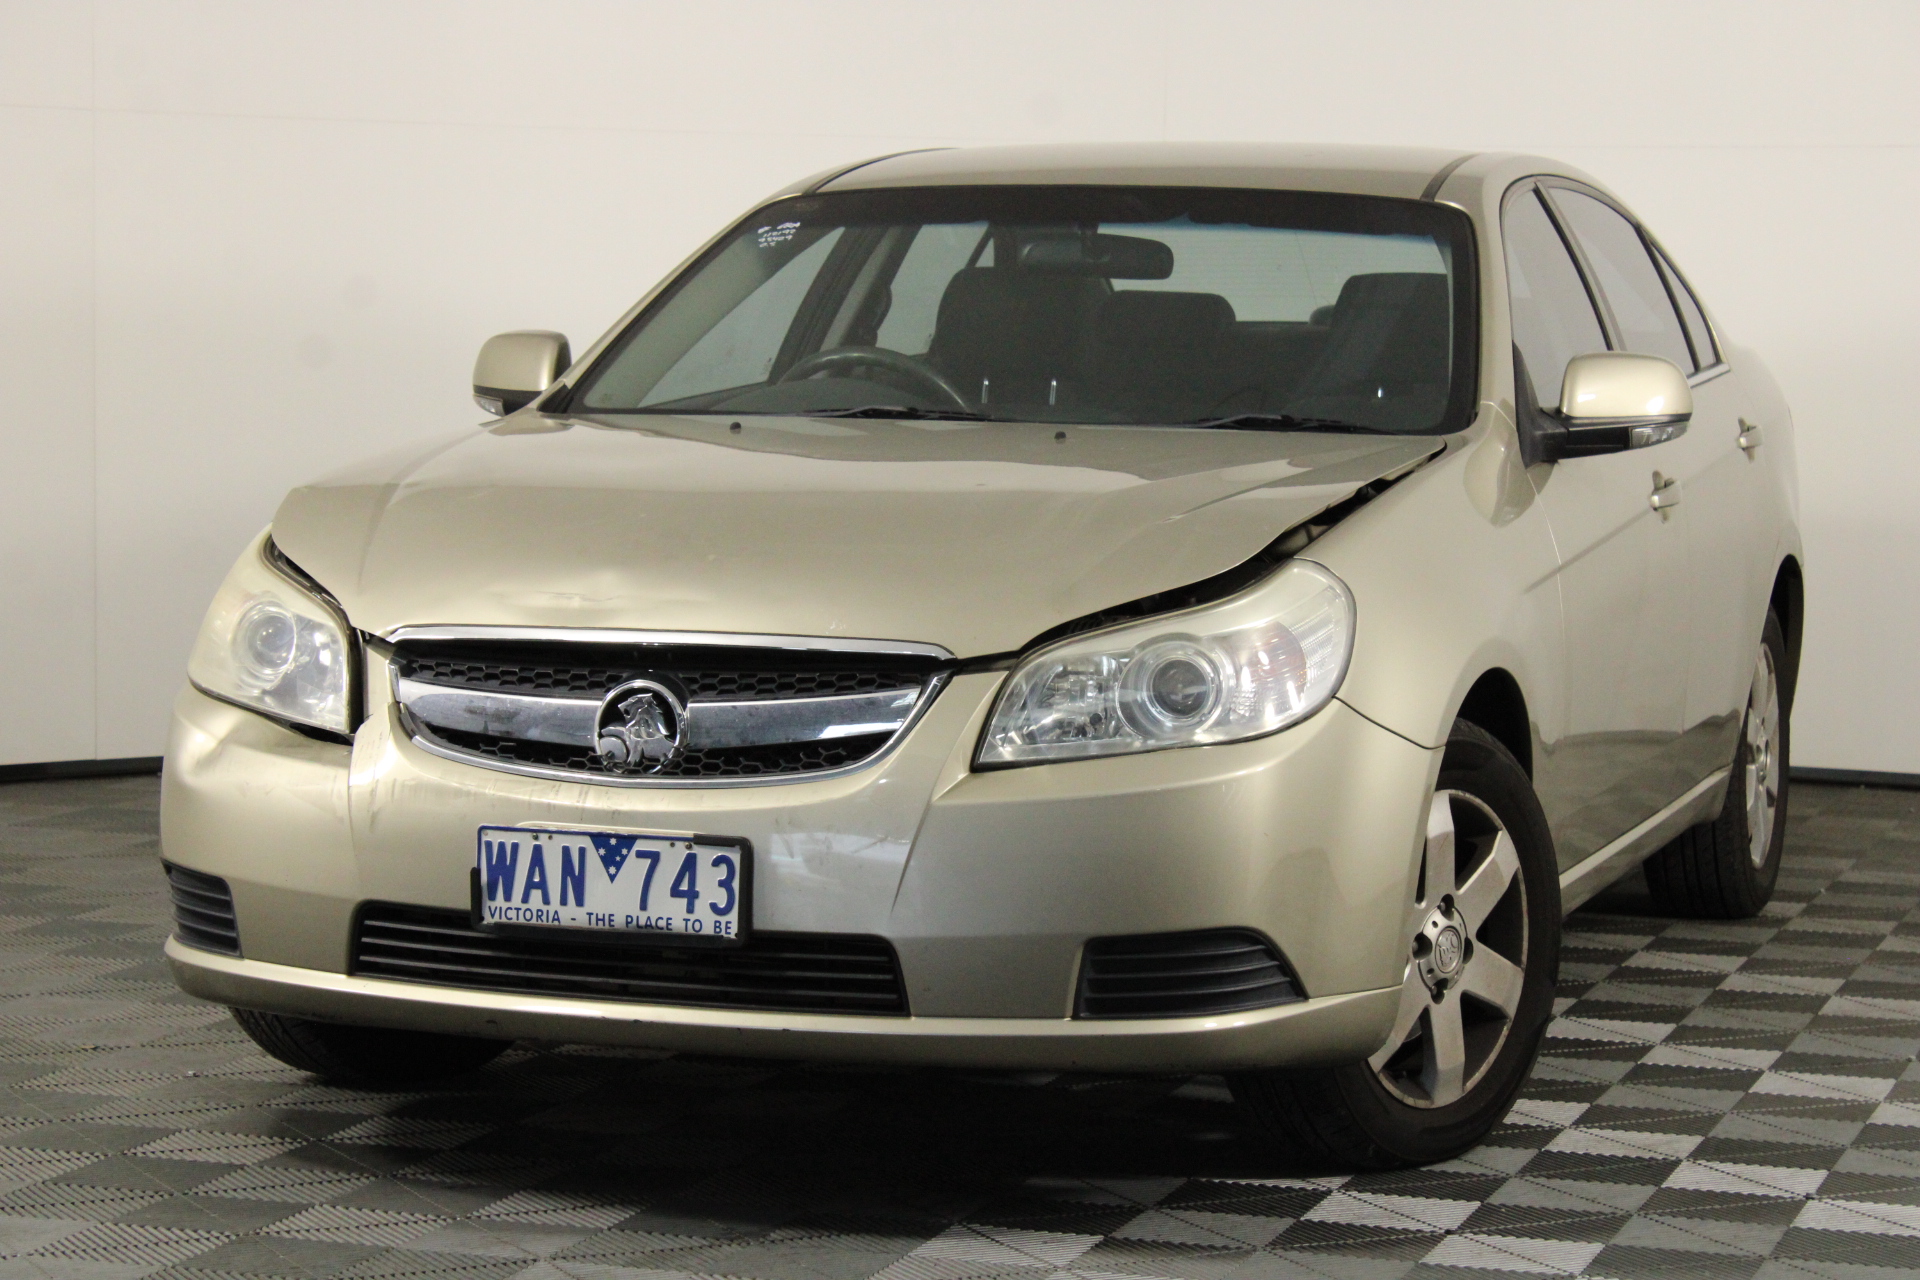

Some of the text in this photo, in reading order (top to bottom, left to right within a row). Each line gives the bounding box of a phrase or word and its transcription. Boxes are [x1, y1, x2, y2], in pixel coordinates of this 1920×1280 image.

[484, 840, 736, 916] WAN 743
[488, 906, 561, 924] VICTORIA
[586, 912, 615, 928] THE
[625, 915, 673, 931] PLACE
[682, 918, 702, 933] TO
[714, 921, 732, 935] BE
